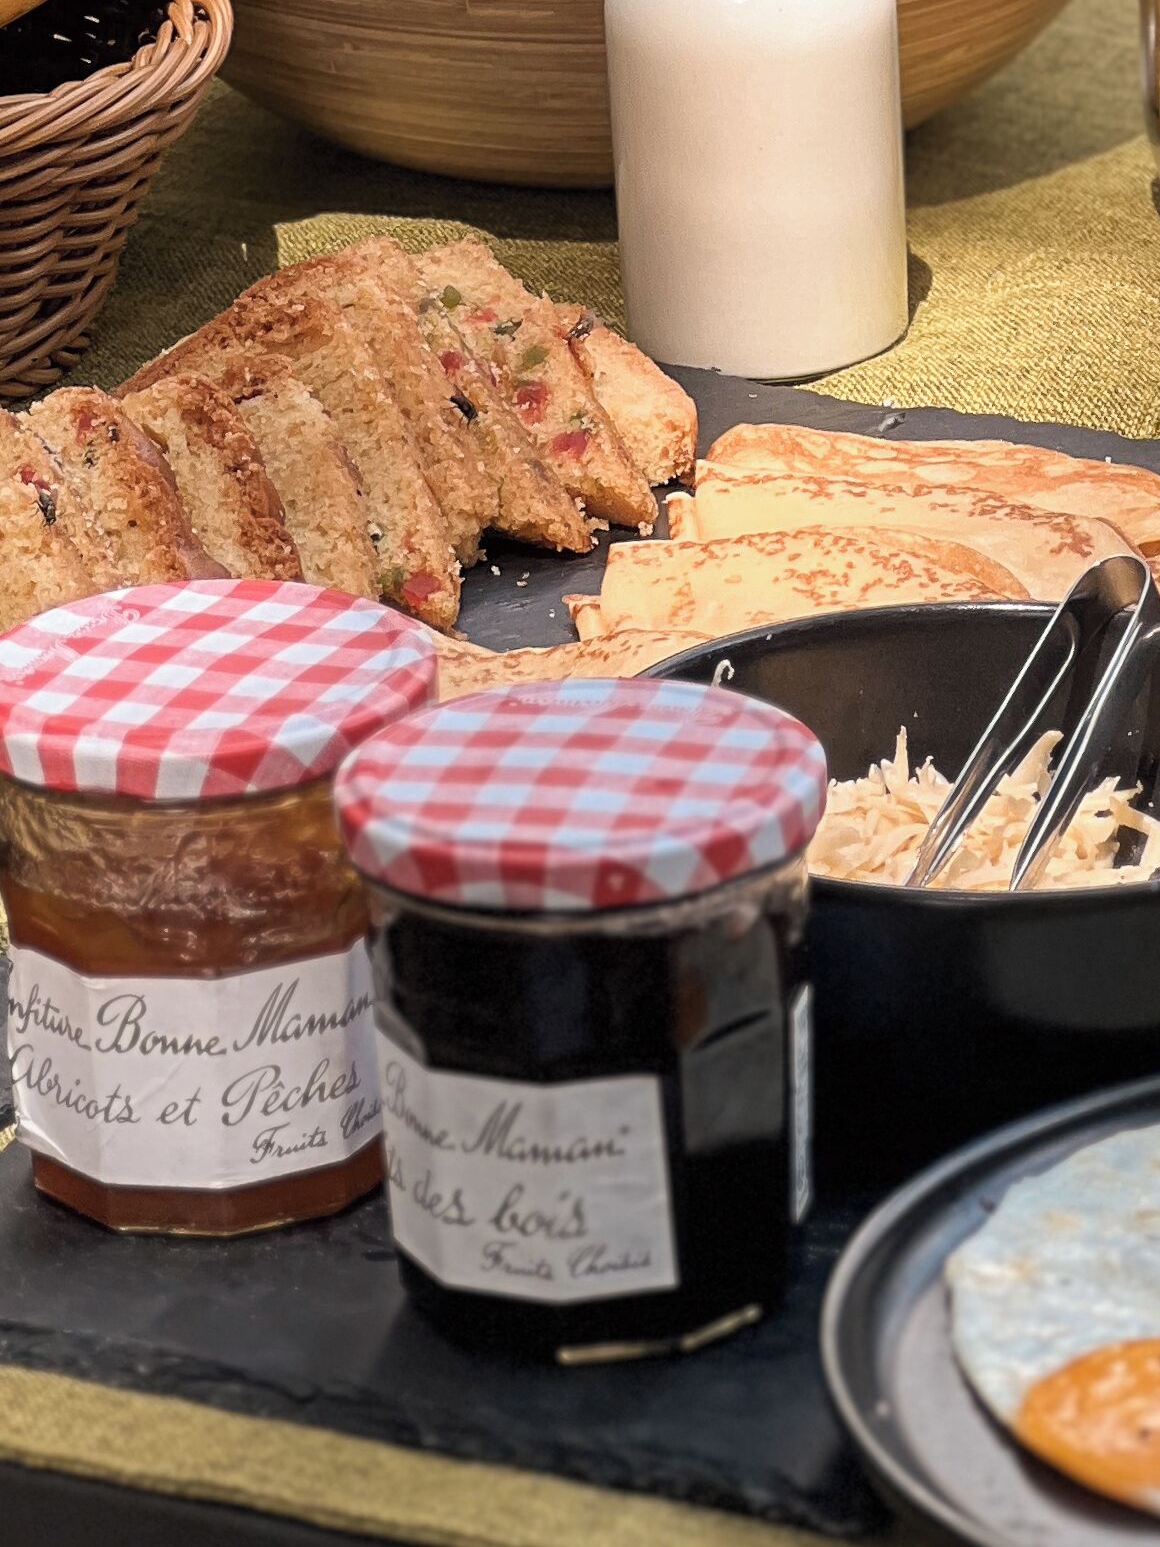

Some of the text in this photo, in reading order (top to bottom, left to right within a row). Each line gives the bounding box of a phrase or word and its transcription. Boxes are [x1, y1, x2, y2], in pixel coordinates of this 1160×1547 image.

[8, 977, 374, 1056] nfiture Bonne Maman
[11, 1043, 362, 1127] Abricots et Pêches
[249, 1121, 329, 1164] Fruits
[461, 1099, 626, 1165] Maman
[412, 1168, 476, 1227] des
[488, 1182, 589, 1239] bois
